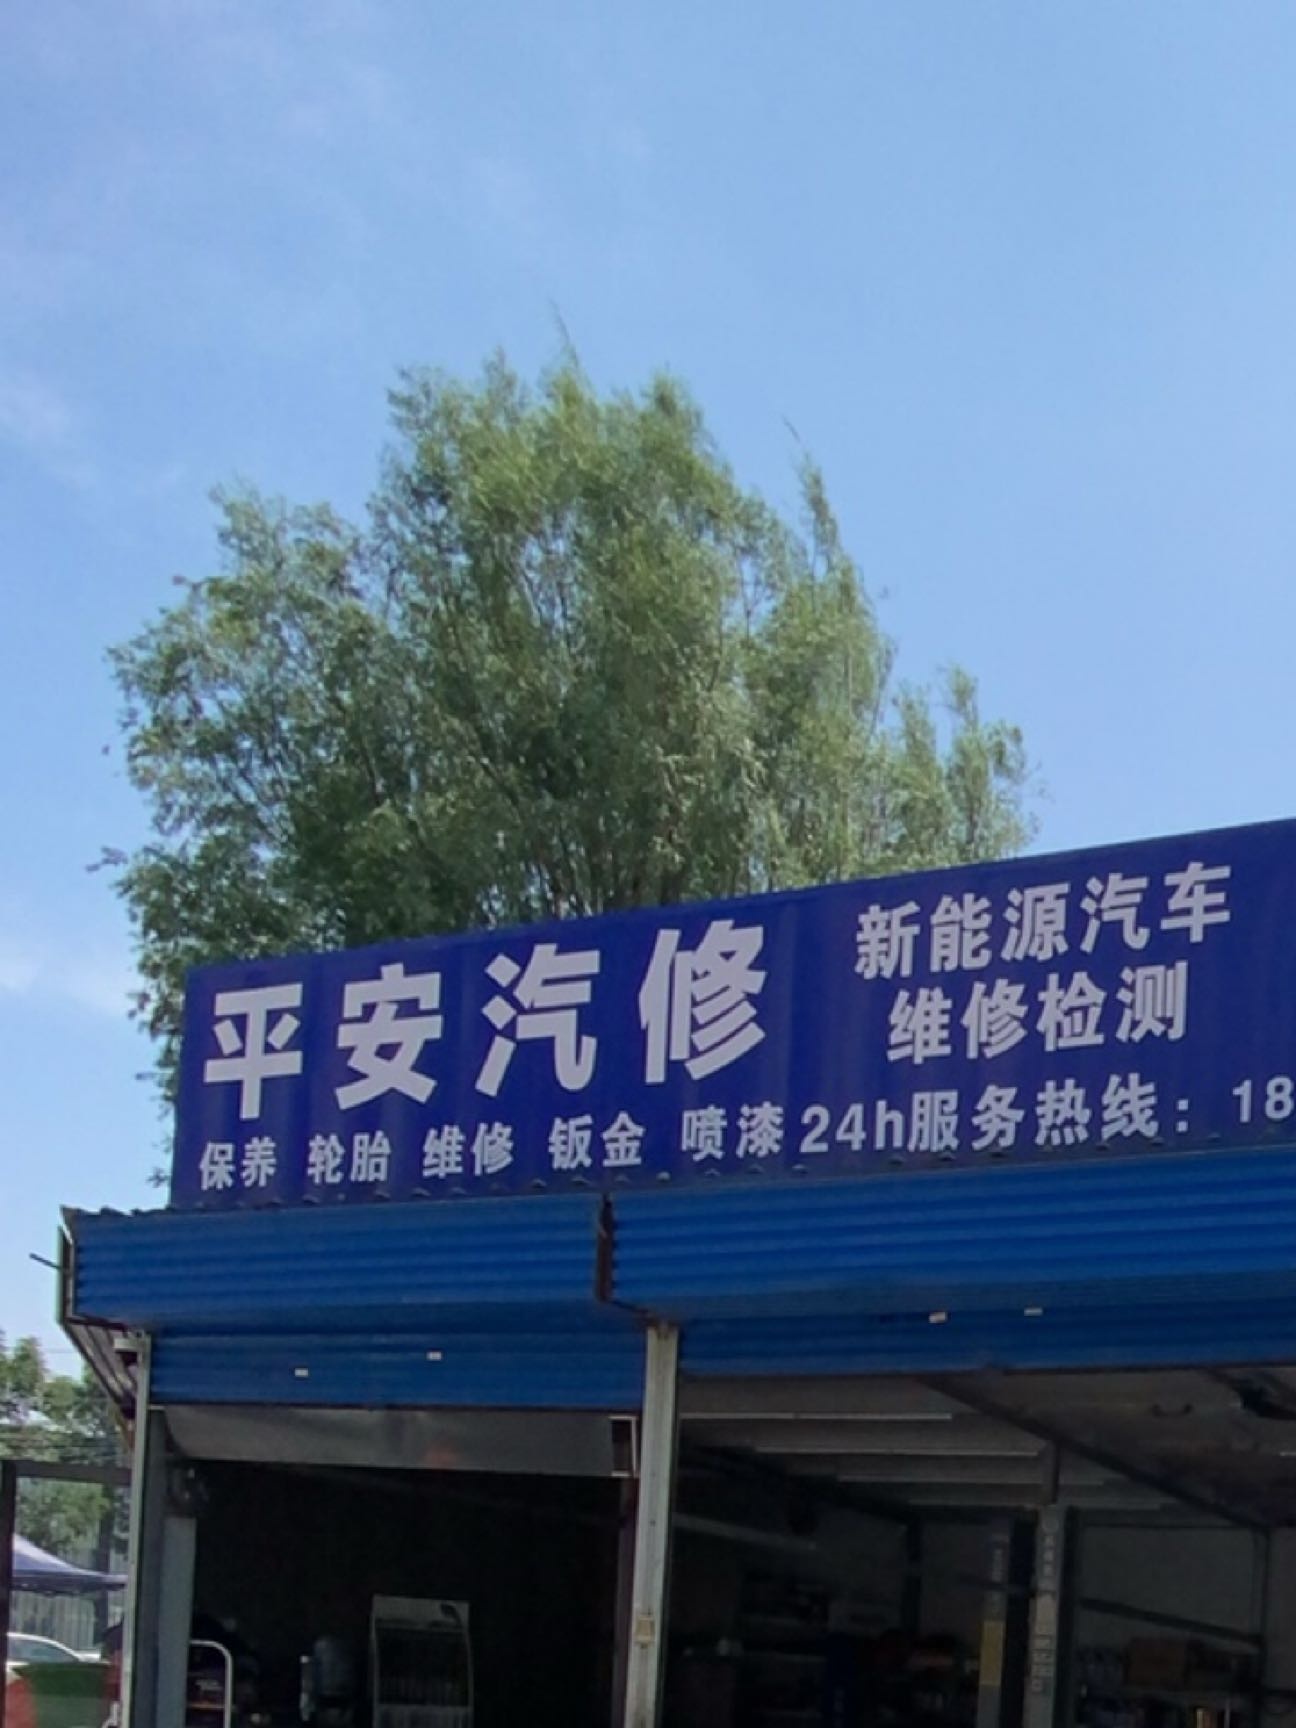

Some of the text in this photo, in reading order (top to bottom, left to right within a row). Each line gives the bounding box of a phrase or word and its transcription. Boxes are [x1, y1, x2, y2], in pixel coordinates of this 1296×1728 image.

[855, 862, 1230, 979] 新能源汽车
[204, 919, 766, 1119] 平安汽修
[887, 961, 1187, 1064] 维修检测
[199, 1136, 276, 1190] 保养
[307, 1130, 391, 1184] 轮胎
[423, 1122, 513, 1177] 维修
[548, 1113, 644, 1169] 钣金
